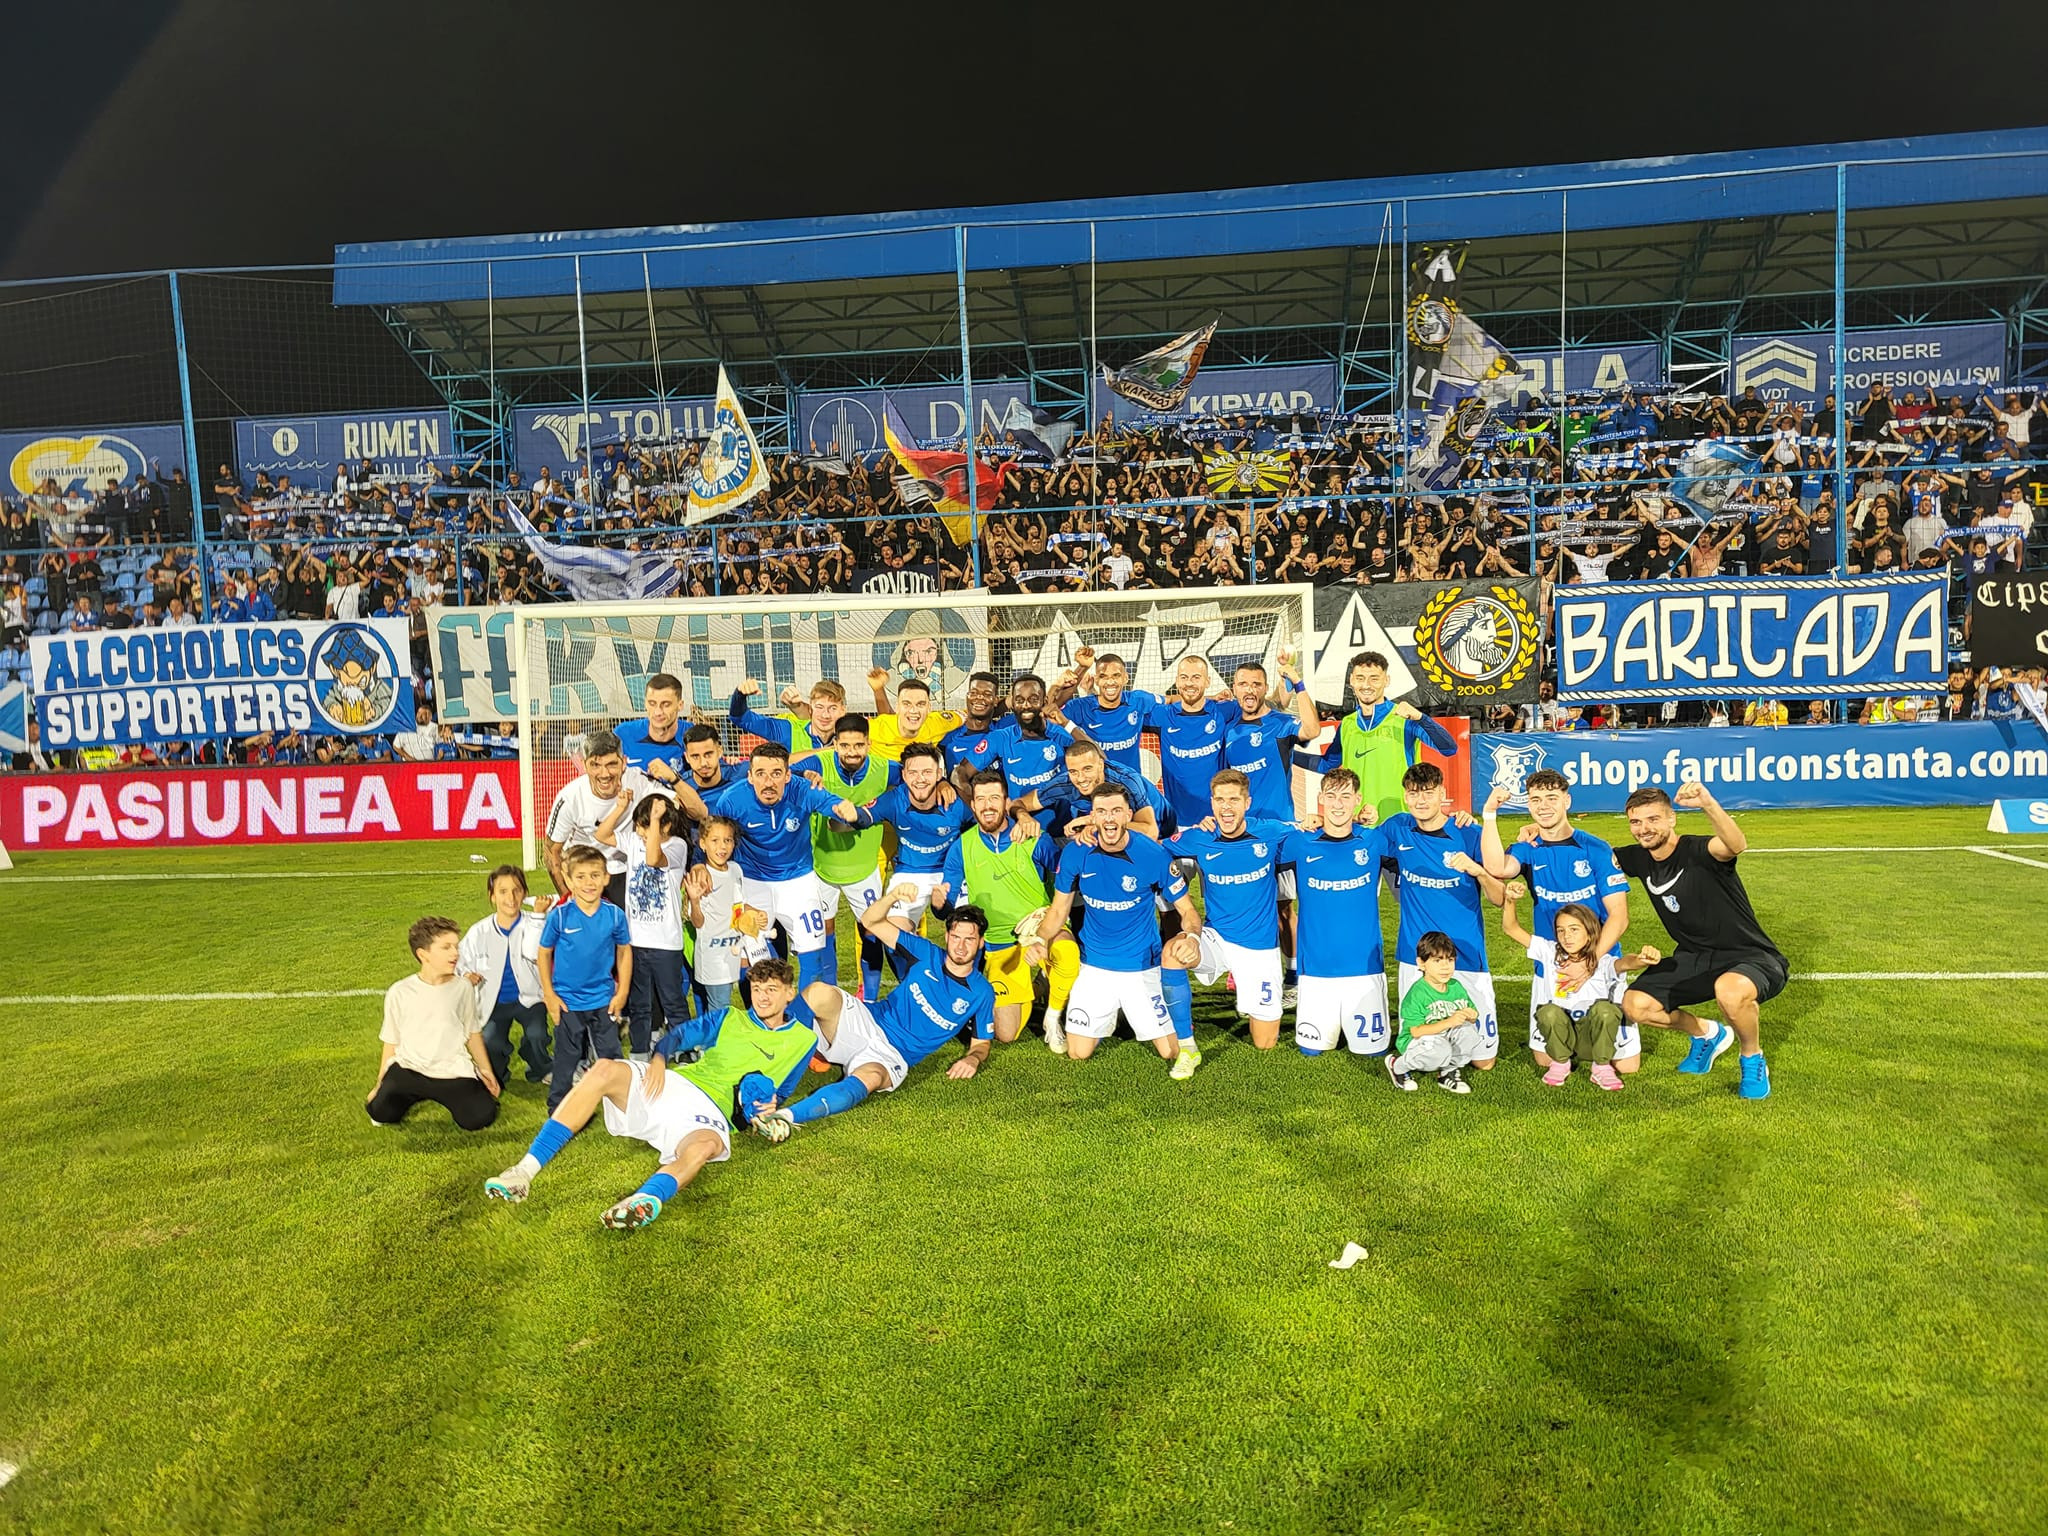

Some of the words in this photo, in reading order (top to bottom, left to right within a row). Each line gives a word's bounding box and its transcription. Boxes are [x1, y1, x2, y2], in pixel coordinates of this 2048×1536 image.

[1761, 387, 1790, 400] VDT
[343, 418, 440, 460] RUMEN
[98, 463, 122, 476] port
[1562, 589, 1943, 686] BARICADA
[43, 628, 308, 692] ALCOHOLICS
[1456, 683, 1497, 697] 2000
[46, 684, 314, 746] SUPPORTERS
[1169, 740, 1222, 759] SUPERBET
[1010, 763, 1062, 787] SUPERBET
[1563, 747, 2048, 790] shop.farulconstanta.com
[23, 775, 401, 844] PASIUNEA
[416, 773, 516, 832] TA
[1208, 862, 1272, 886] SUPERBET
[1307, 872, 1372, 892] SUPERBET
[863, 888, 877, 907] 8
[1082, 894, 1142, 912] SUPERBET
[1534, 884, 1596, 904] SUPERBET
[800, 908, 823, 934] 18
[1261, 981, 1272, 1002] 5
[909, 982, 958, 1031] SUPERBET
[1354, 1012, 1384, 1038] 24
